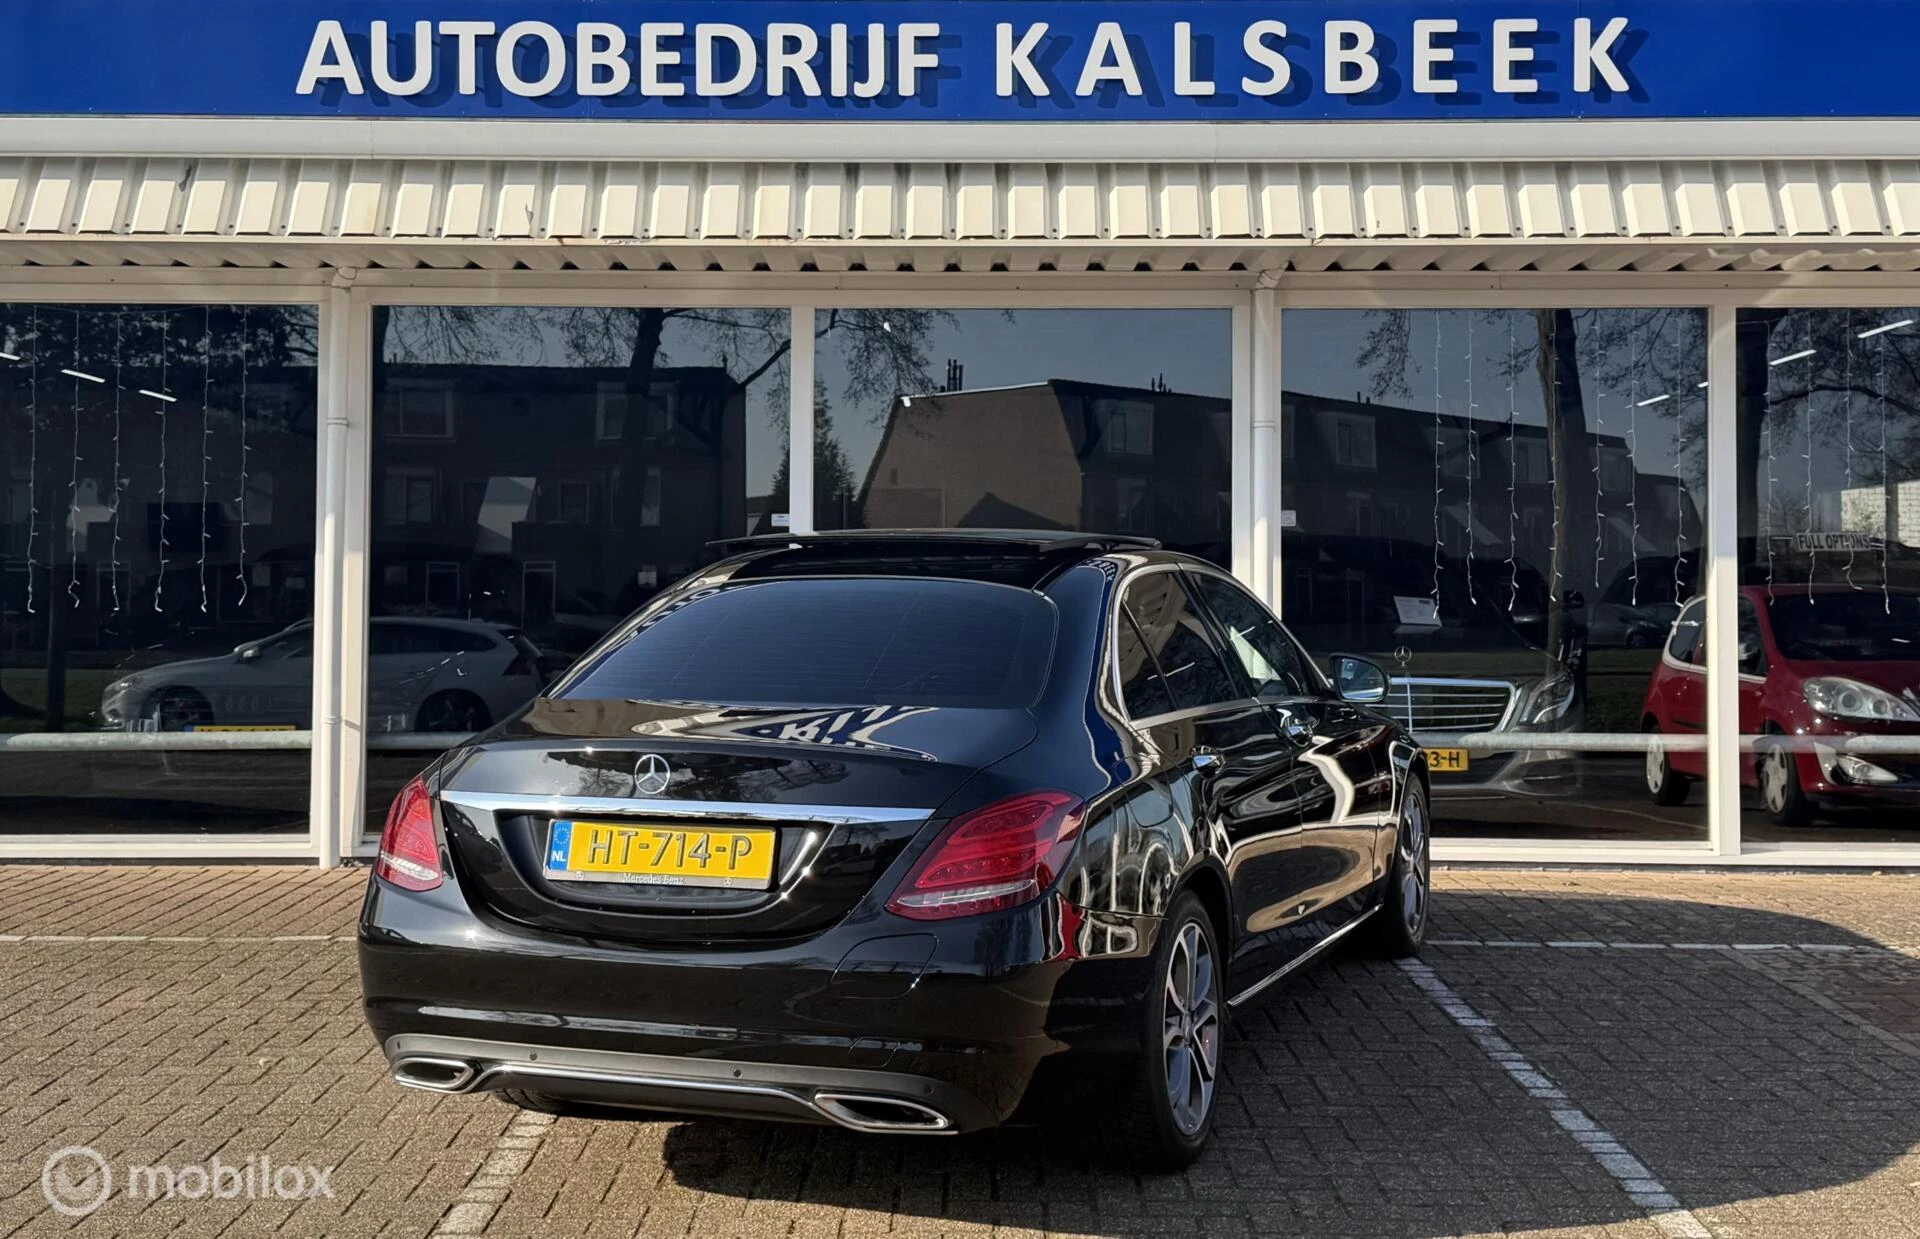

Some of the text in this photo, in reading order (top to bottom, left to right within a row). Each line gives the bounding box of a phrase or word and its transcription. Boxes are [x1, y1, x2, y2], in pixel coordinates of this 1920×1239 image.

[295, 17, 1629, 98] AUTOBEDRIJF KALSBEEK
[1798, 533, 1825, 549] FULL
[1424, 751, 1459, 768] 3-H
[551, 850, 566, 862] NL
[587, 829, 753, 870] HT-714-P
